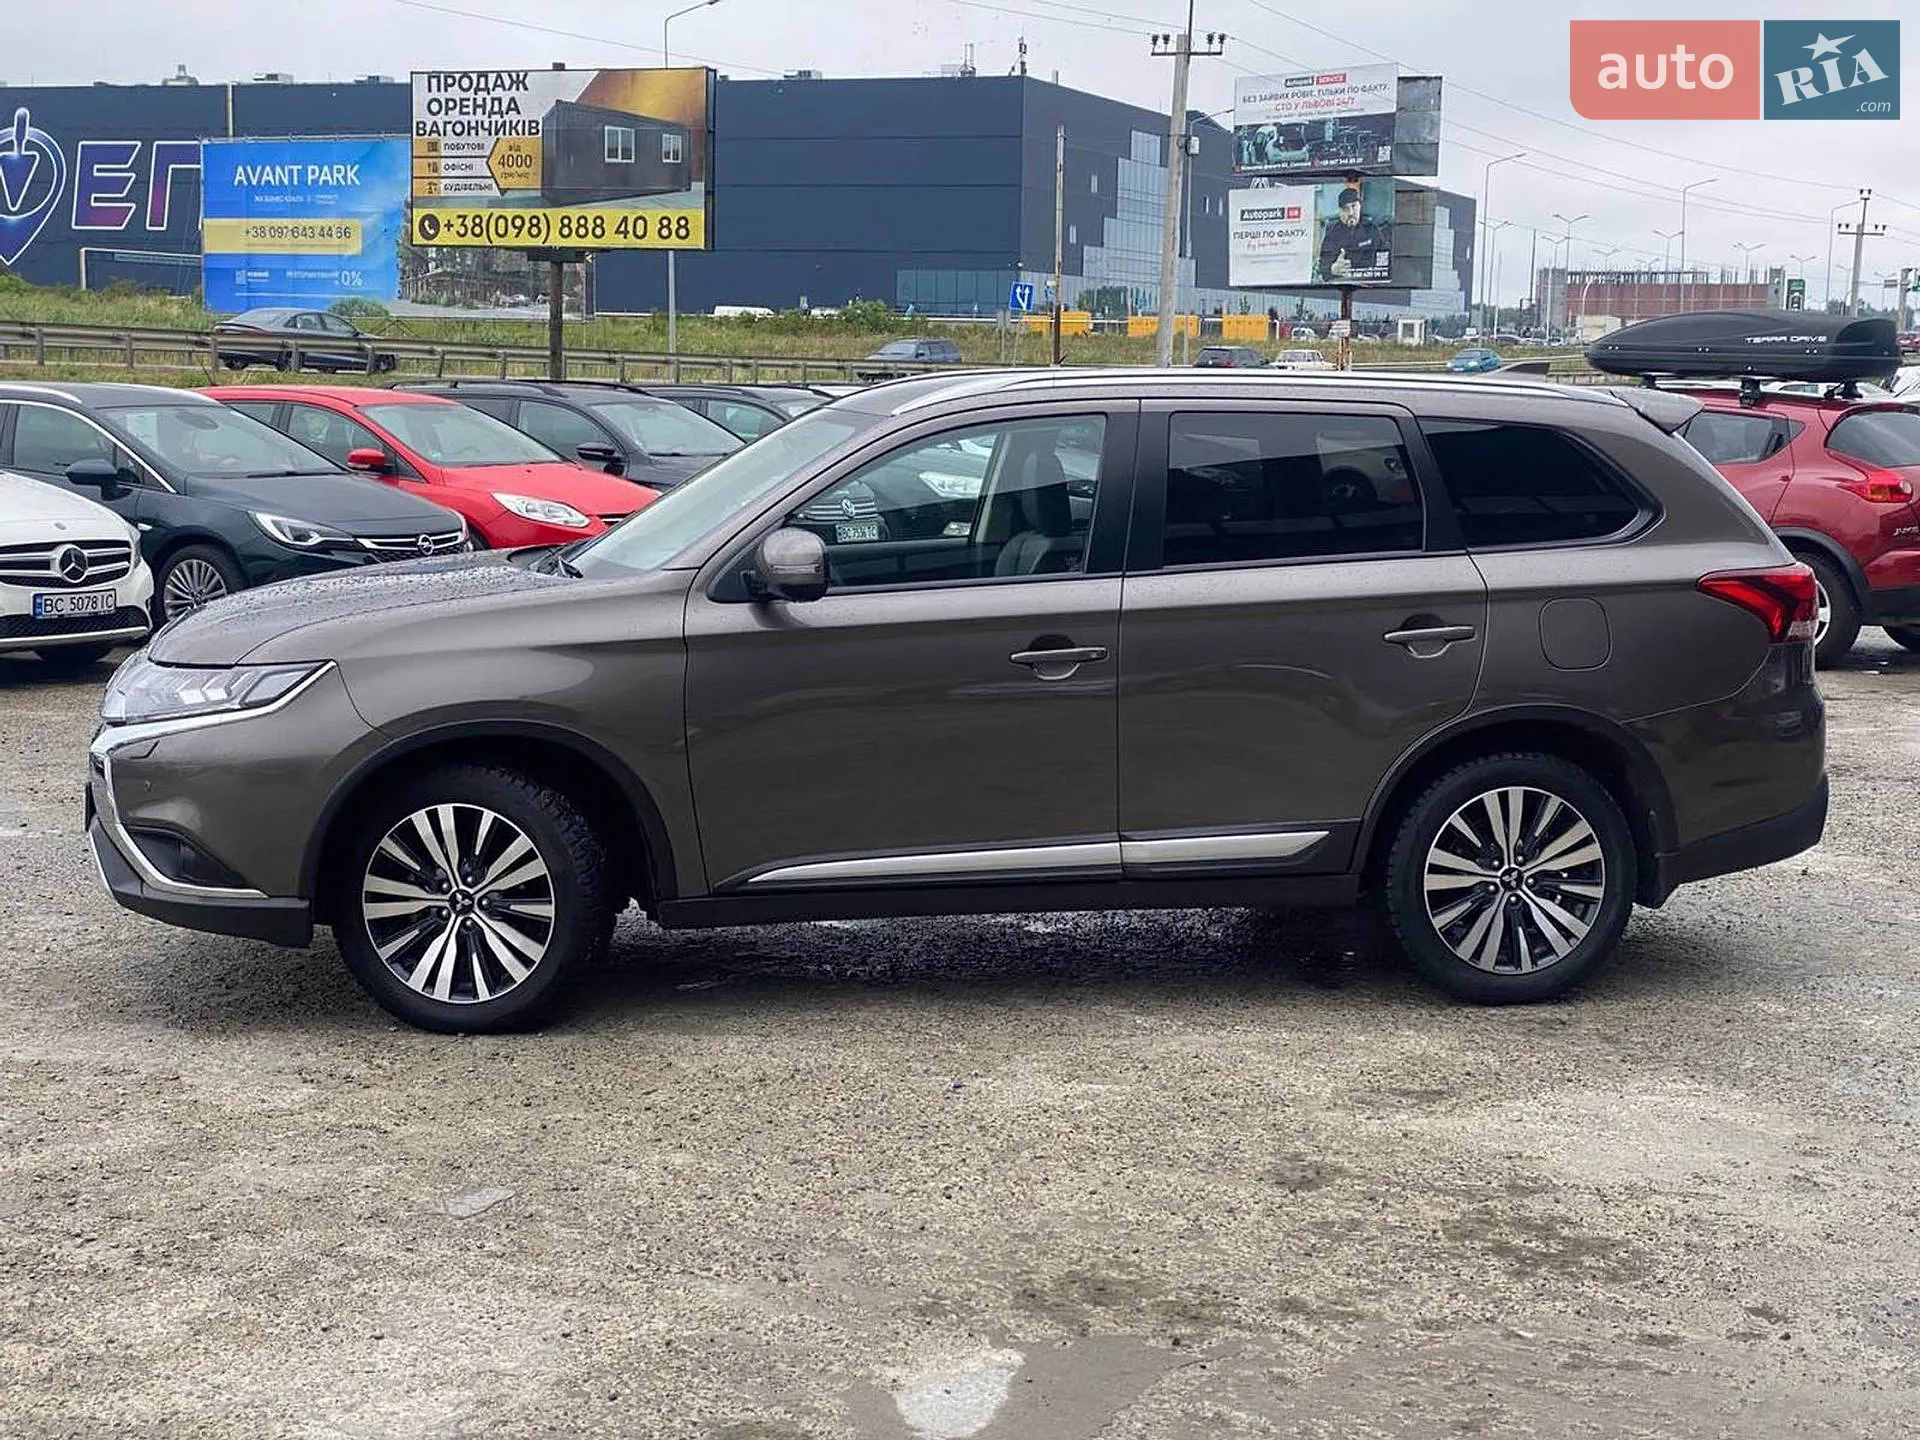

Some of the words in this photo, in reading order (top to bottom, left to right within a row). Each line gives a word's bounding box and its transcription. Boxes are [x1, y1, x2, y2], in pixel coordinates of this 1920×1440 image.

[427, 73, 529, 95] ПРОДАЖ
[427, 96, 521, 118] ОРЕНДА
[416, 120, 540, 136] ВАГОНЧИКІВ
[444, 142, 485, 151] ПОБУТОВІ
[498, 154, 533, 169] 4000
[234, 165, 302, 186] AVANT
[308, 164, 361, 186] PARK
[444, 182, 493, 192] БУДІВЕЛЬНІ
[1243, 208, 1283, 220] Autopark
[318, 226, 334, 238] 44
[444, 213, 550, 244] +38(098)
[559, 215, 606, 239] 888
[615, 215, 648, 239] 40
[657, 216, 691, 240] 88
[1263, 231, 1275, 239] ПО
[1745, 336, 1787, 344] TERRA
[1789, 335, 1827, 343] DRIVE
[44, 598, 65, 613] BC
[69, 596, 97, 612] 5078
[100, 594, 114, 609] IC
